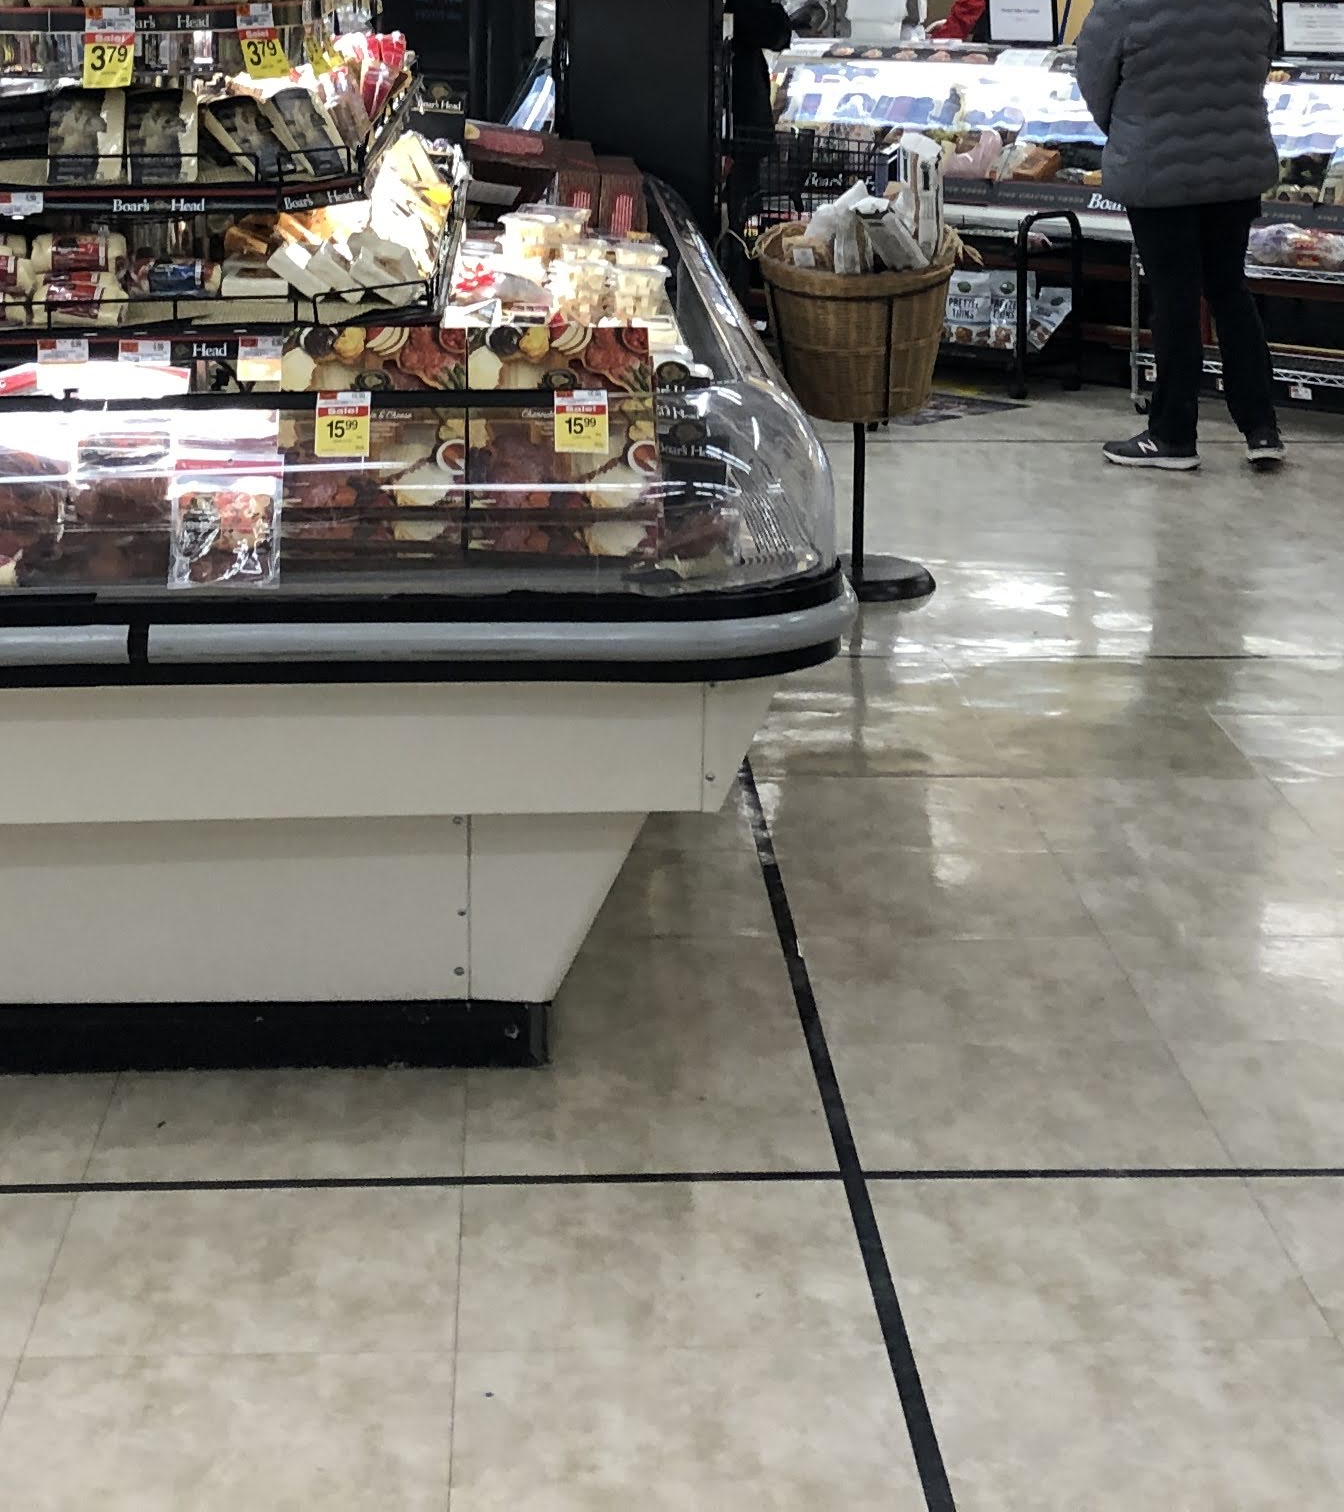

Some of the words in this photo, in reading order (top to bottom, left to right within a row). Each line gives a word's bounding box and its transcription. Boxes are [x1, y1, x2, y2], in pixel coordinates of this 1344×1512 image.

[177, 13, 210, 28] Head
[90, 44, 128, 72] 379
[246, 40, 278, 66] 379
[112, 198, 150, 213] Boar's
[170, 197, 205, 212] Head
[284, 196, 314, 210] Boar's
[327, 188, 355, 204] Head
[192, 342, 227, 358] Head
[326, 419, 359, 439] 1599
[564, 416, 597, 435] 1599
